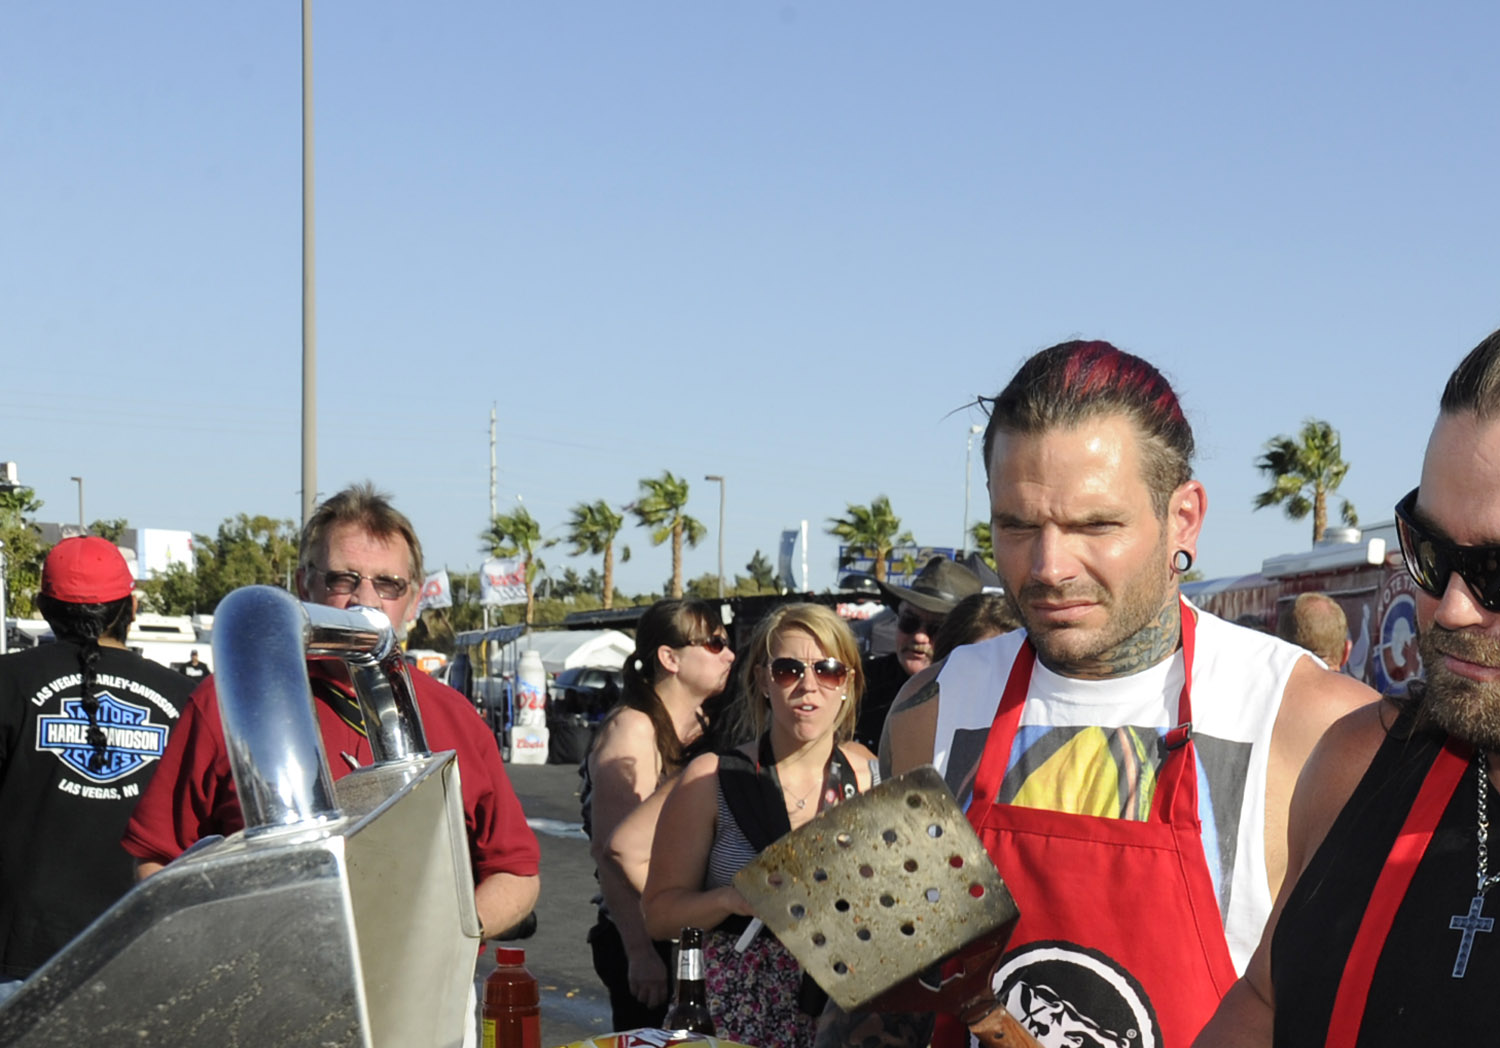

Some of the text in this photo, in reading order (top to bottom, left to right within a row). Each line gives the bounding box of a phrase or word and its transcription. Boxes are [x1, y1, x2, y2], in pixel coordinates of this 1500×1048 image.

[32, 673, 177, 718] LAS VEGAS ARLEY-DAVIDSON
[77, 701, 133, 724] MTOR
[73, 750, 131, 774] CYLES
[58, 779, 139, 800] LAS VEGAS, NV
